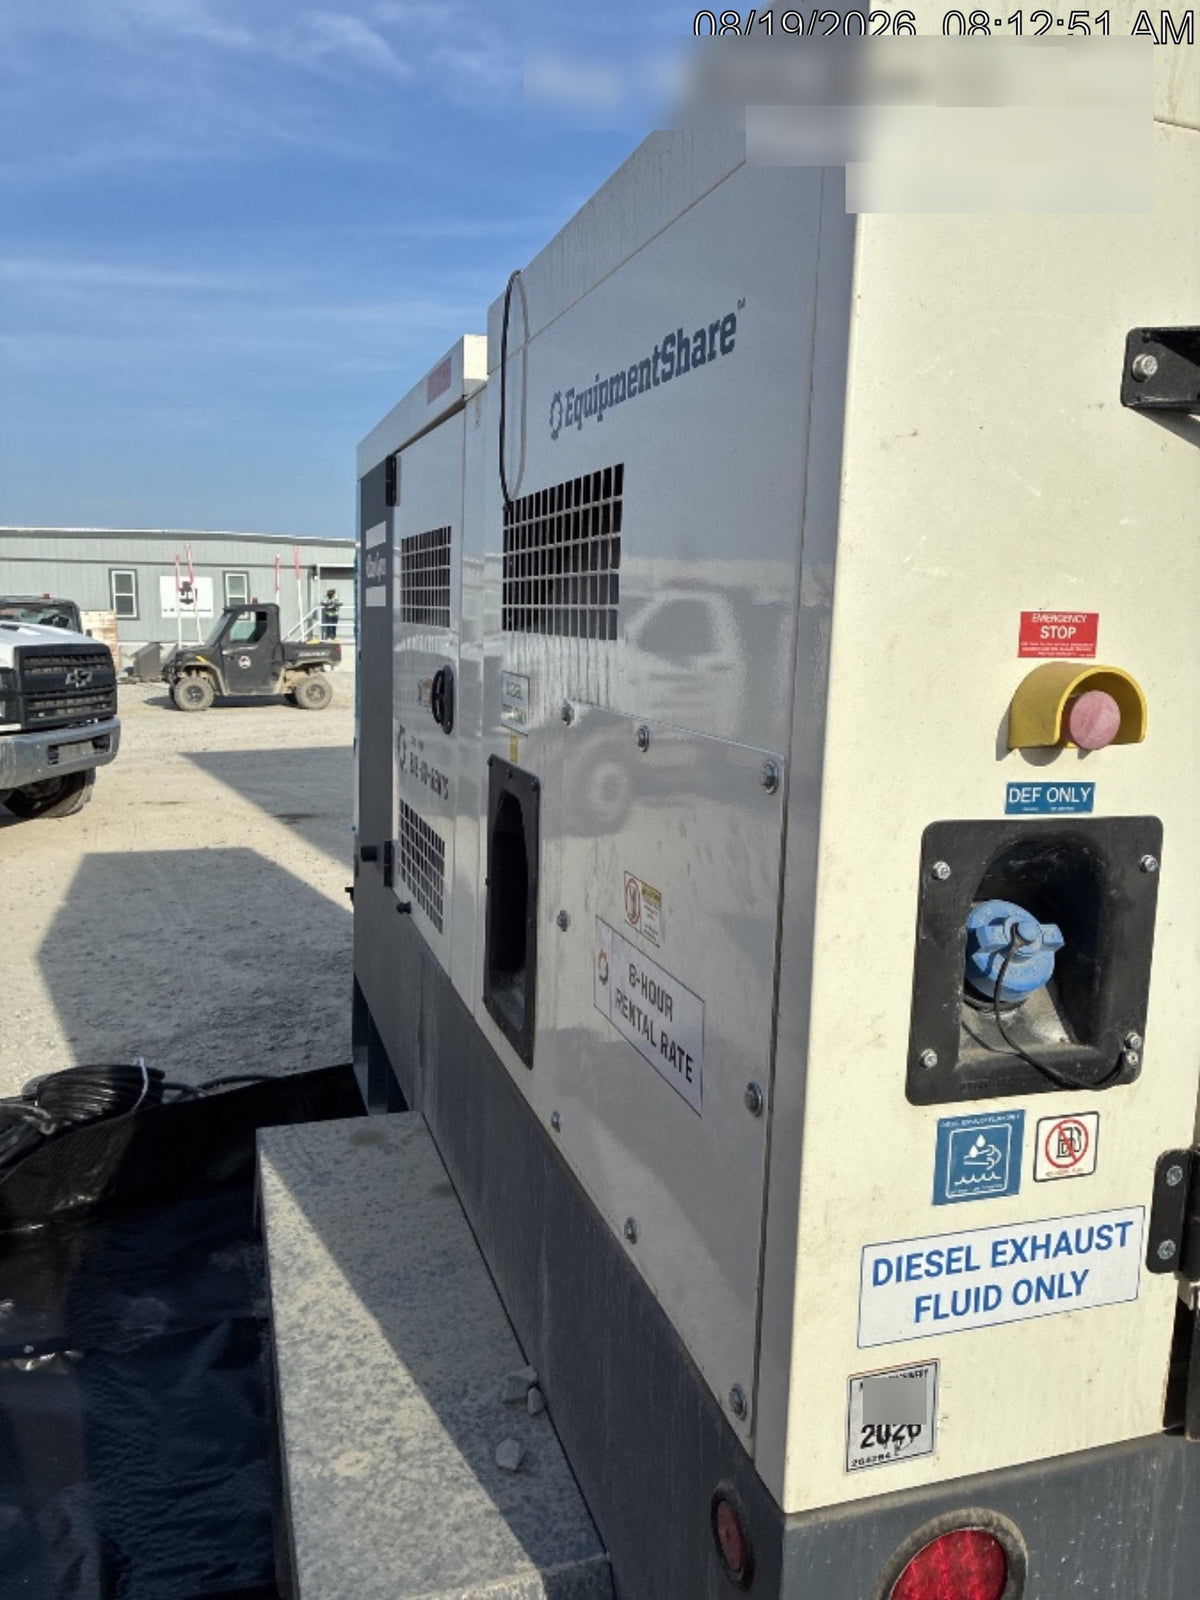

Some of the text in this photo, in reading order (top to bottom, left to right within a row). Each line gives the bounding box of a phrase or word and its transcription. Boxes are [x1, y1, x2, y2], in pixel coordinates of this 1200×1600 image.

[565, 312, 737, 430] EquipmentShare
[1032, 613, 1087, 623] EMERGENCY
[1040, 625, 1077, 639] STOP
[1009, 787, 1091, 803] DEF ONLY
[614, 988, 693, 1084] RENTAL RATE
[872, 1221, 1133, 1287] DIESEL EXHAUST
[914, 1269, 1090, 1323] FLUID ONLY
